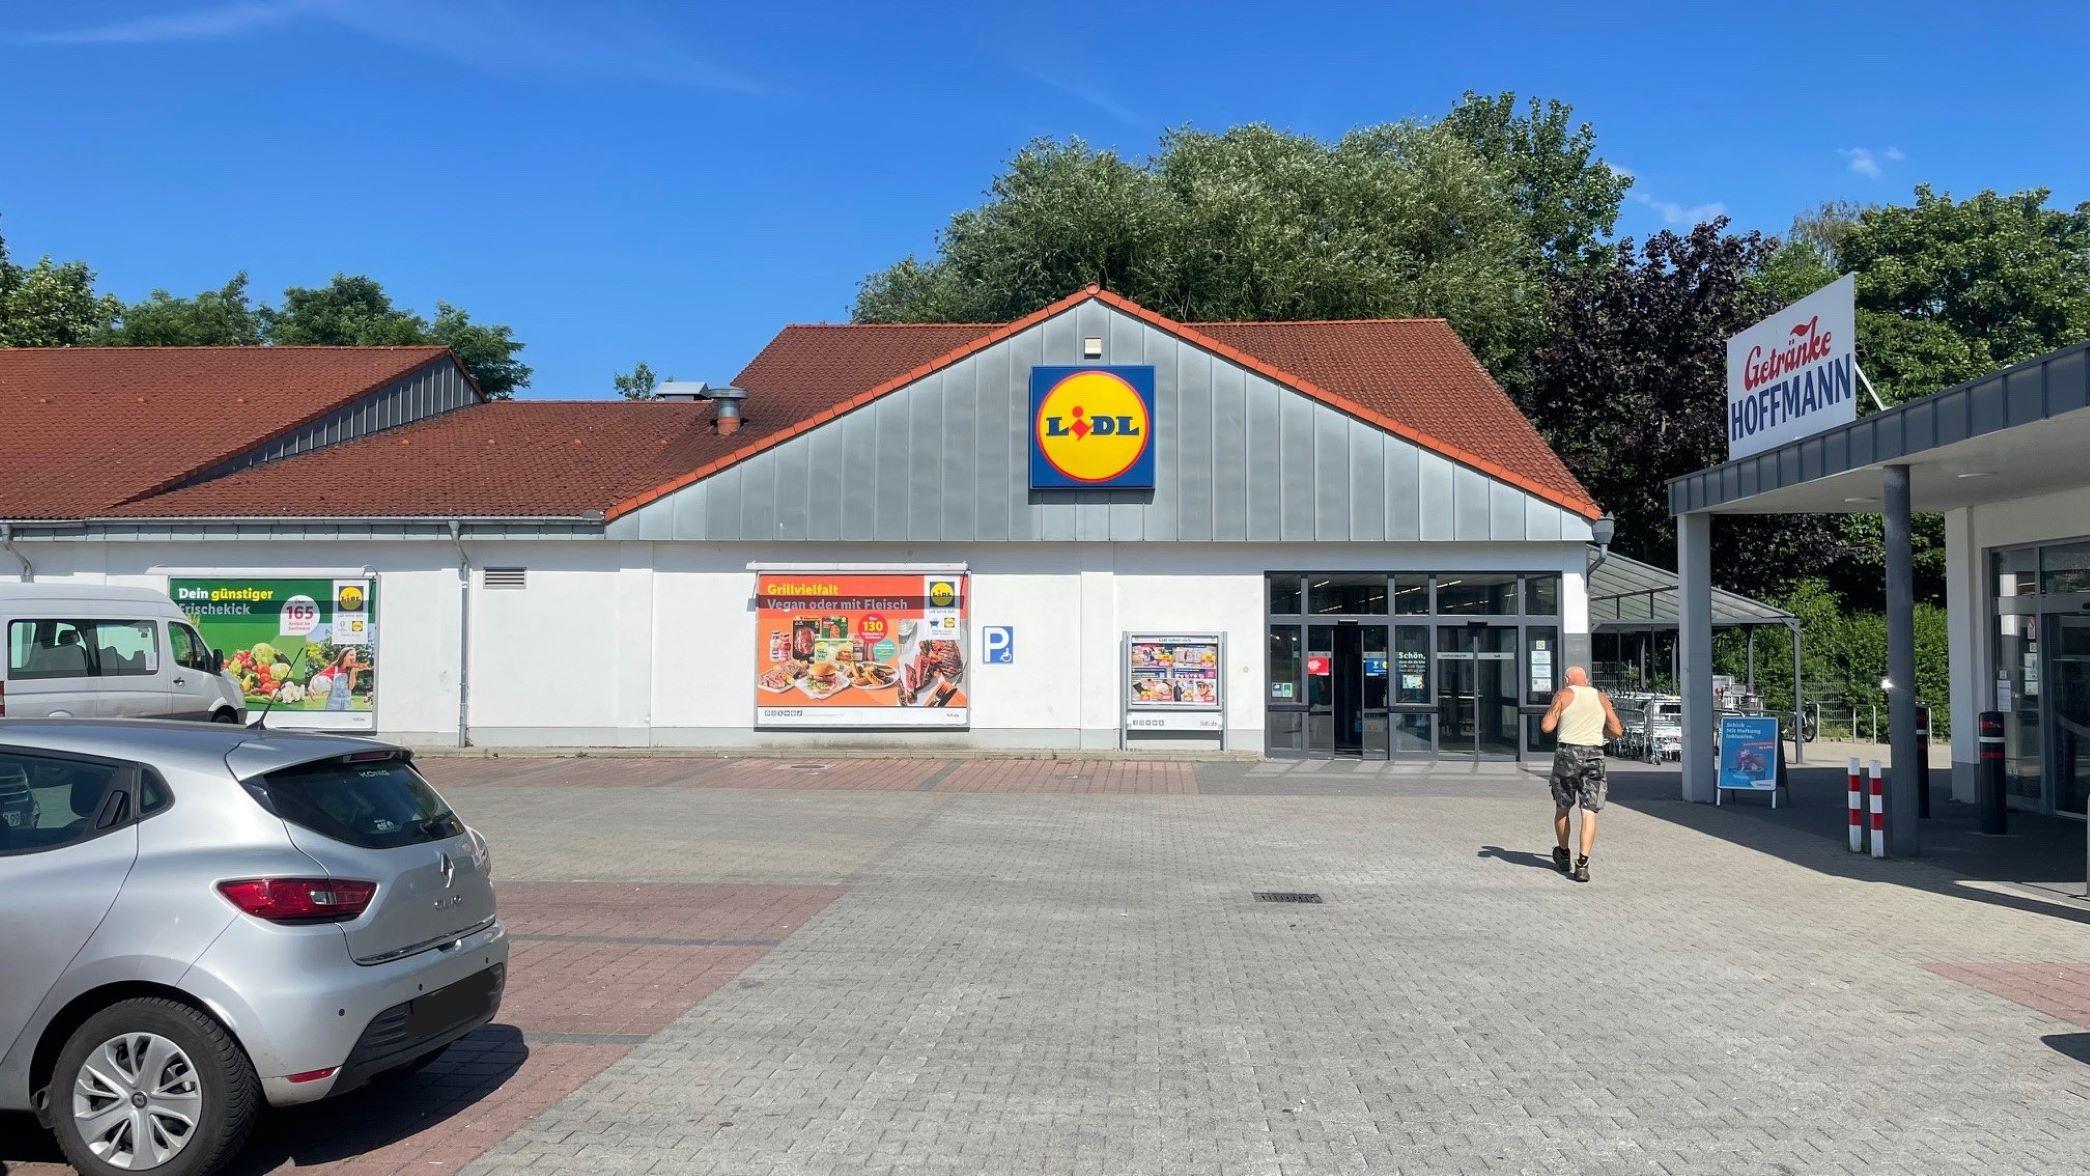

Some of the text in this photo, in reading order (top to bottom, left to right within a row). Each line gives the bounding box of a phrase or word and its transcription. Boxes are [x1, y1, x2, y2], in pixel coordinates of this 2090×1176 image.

[1744, 315, 1832, 391] Getränke
[1731, 353, 1851, 442] HOFFMANN
[178, 588, 273, 601] Dein günstiger
[767, 584, 839, 596] Grillvielfalt
[767, 598, 908, 612] Vegan oder mit Fleisch
[286, 606, 314, 620] 165
[862, 621, 884, 632] 130
[1398, 651, 1426, 660] Schön,
